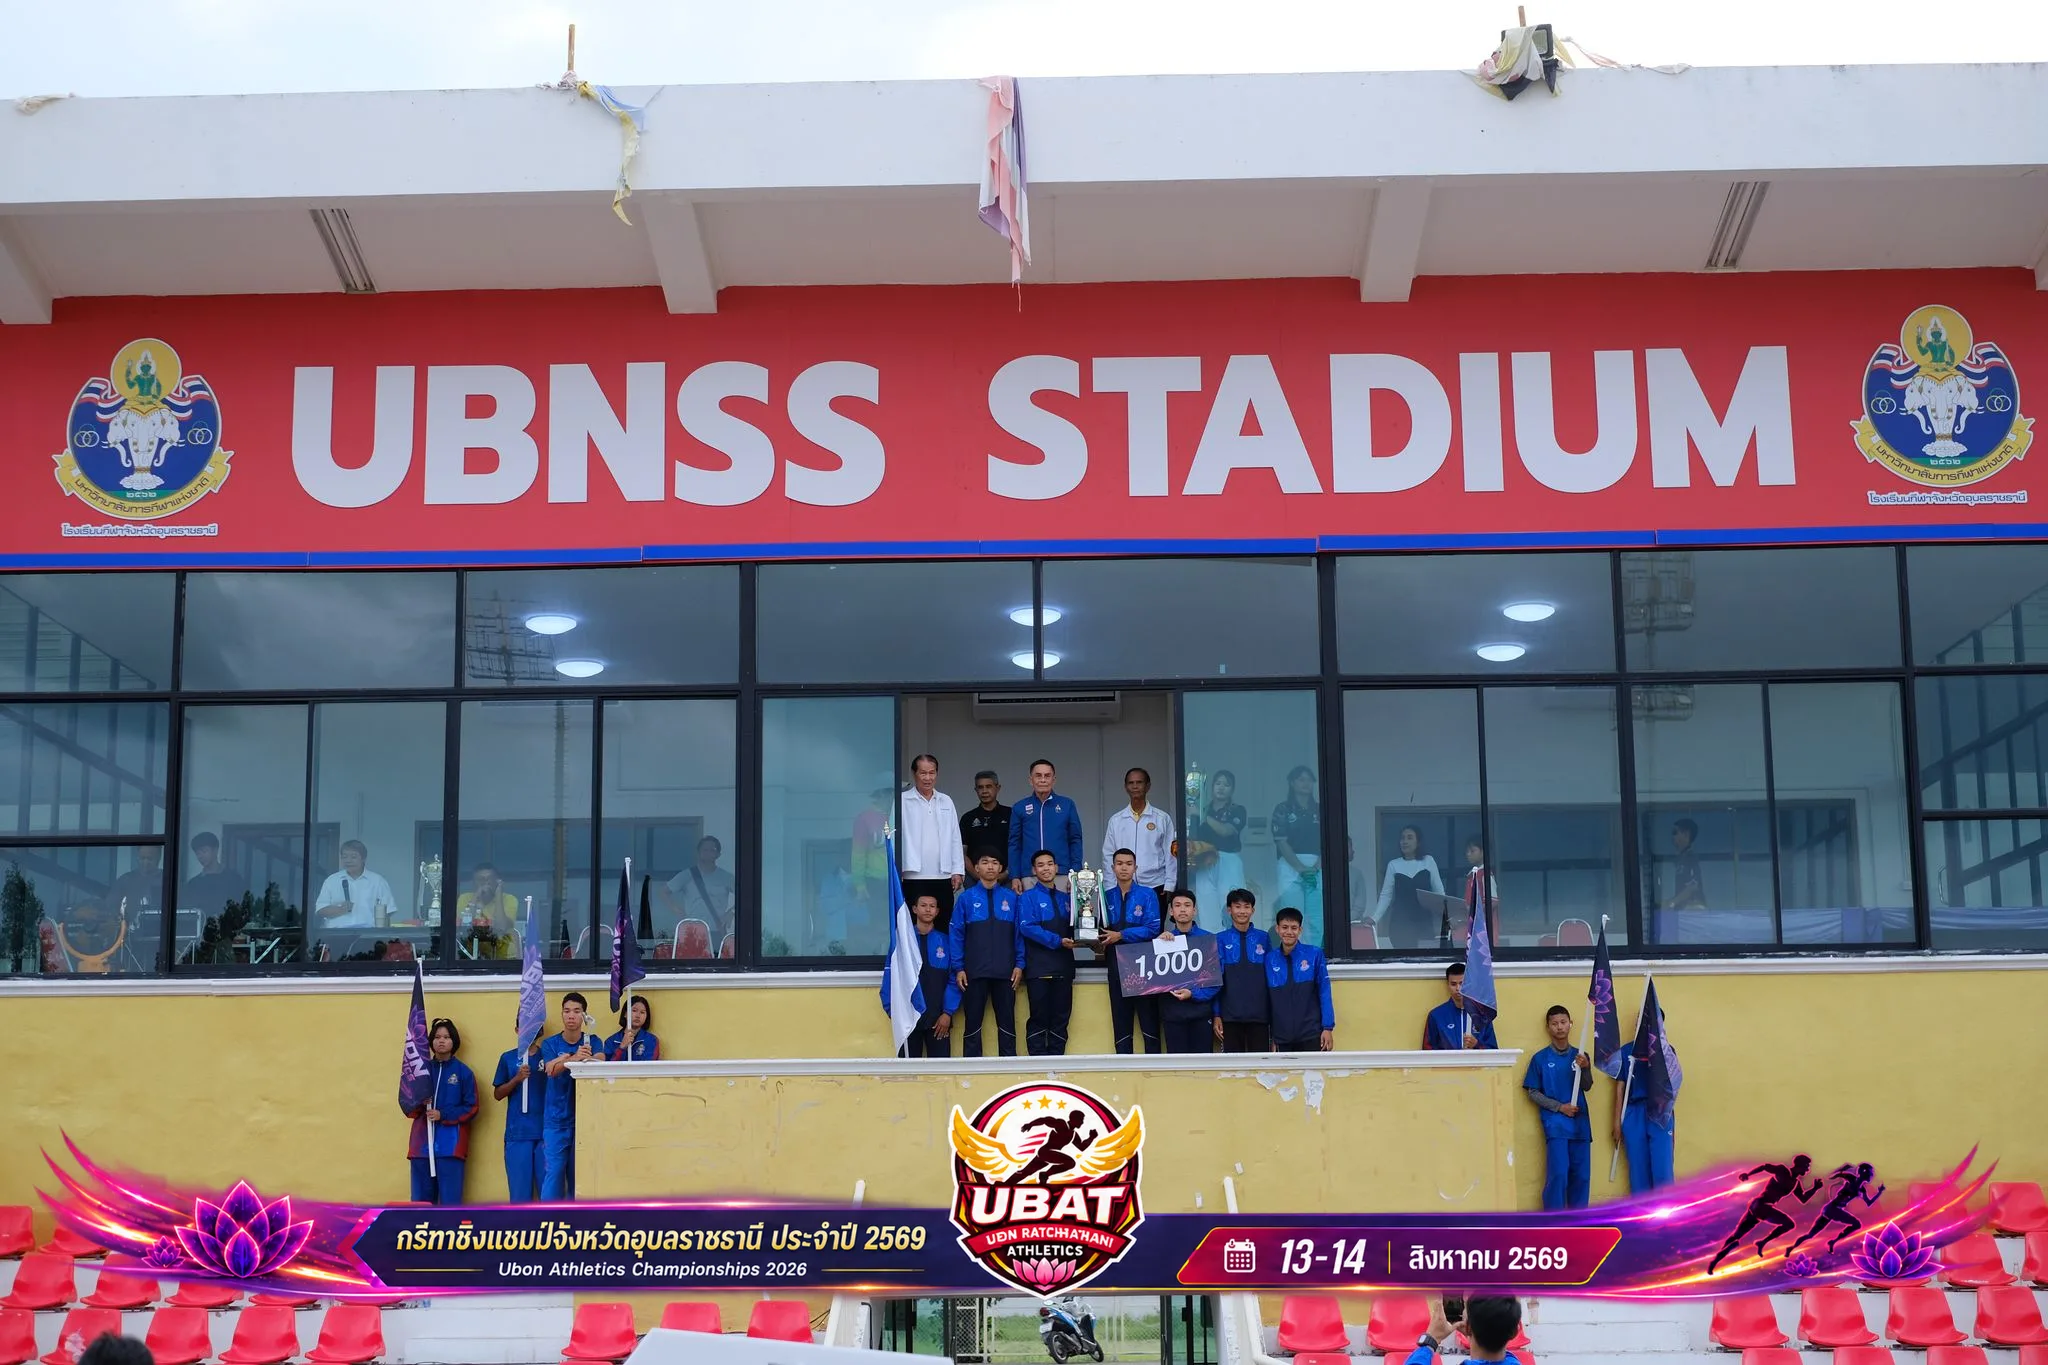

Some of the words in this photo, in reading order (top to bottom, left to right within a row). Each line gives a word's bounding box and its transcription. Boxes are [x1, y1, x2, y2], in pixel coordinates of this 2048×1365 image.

[292, 360, 886, 508] UBNSS
[988, 345, 1797, 500] STADIUM
[1135, 948, 1203, 980] 1,000
